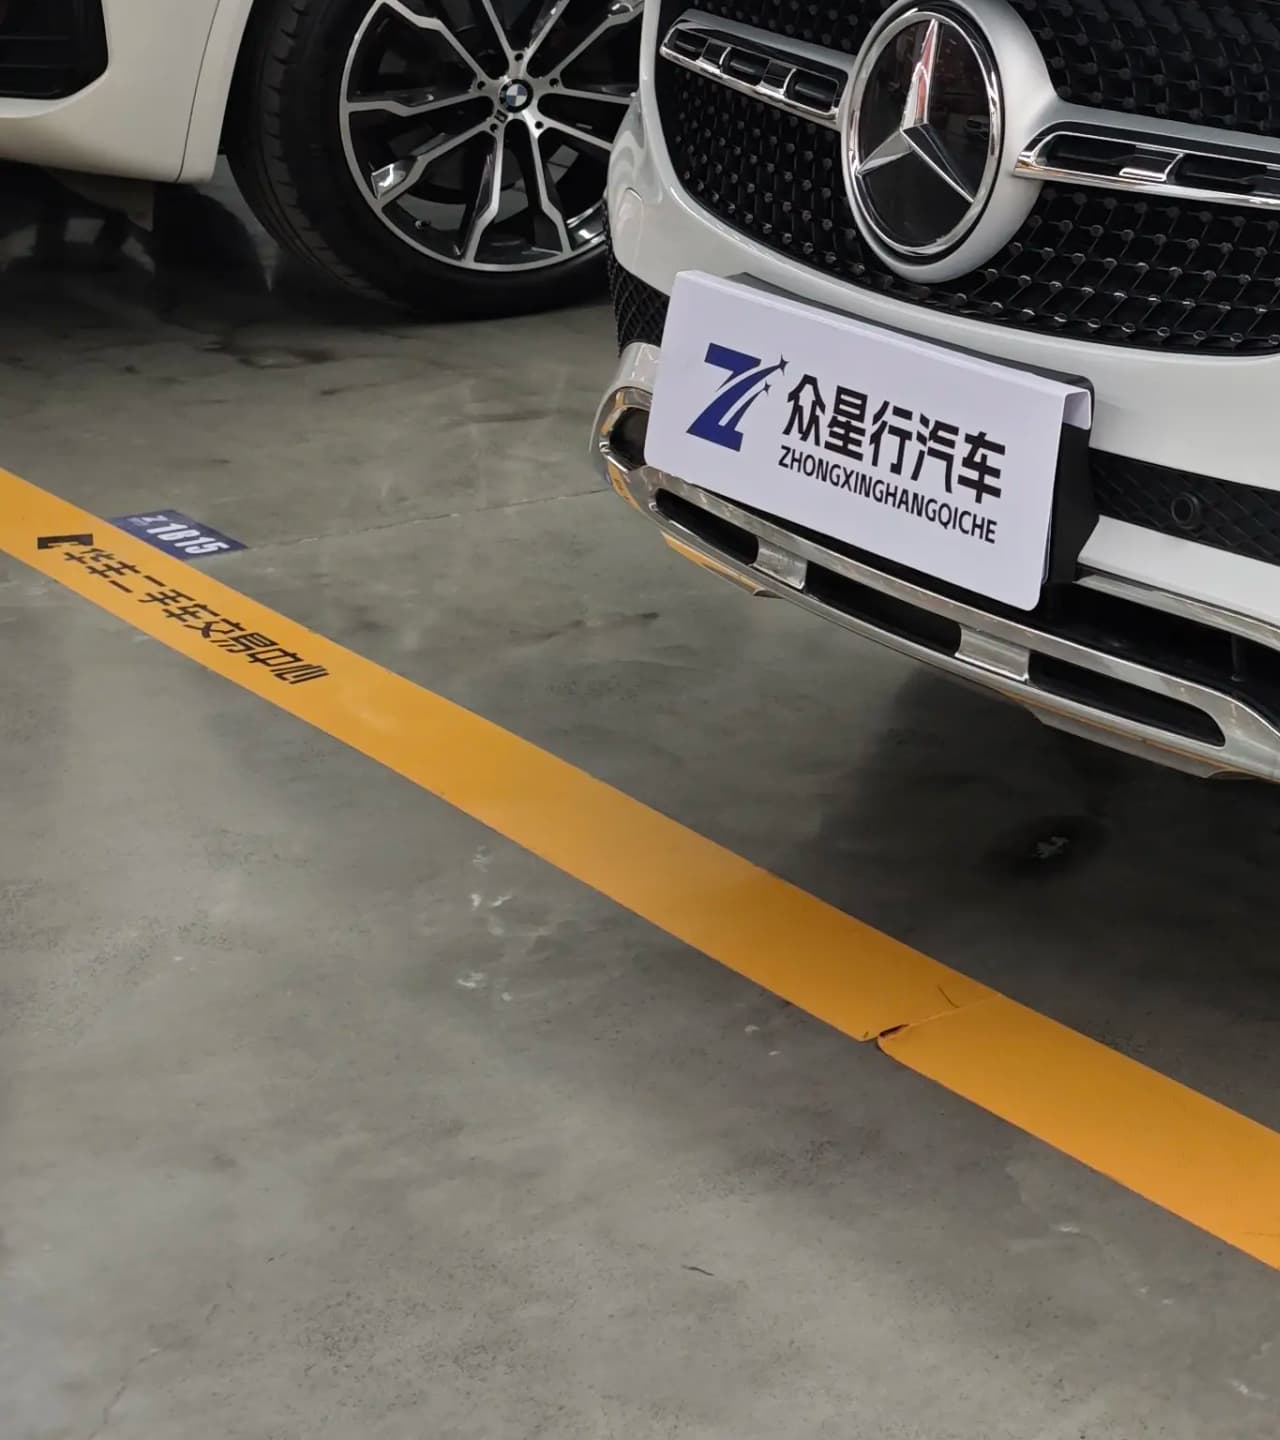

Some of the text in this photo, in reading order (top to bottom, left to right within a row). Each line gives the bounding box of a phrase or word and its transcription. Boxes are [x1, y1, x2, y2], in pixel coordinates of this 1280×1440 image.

[779, 446, 998, 545] ZHONGXINGHANGQICHE
[783, 373, 1006, 504] 众星行汽车
[62, 548, 330, 685] 华丰二手车交易中心
